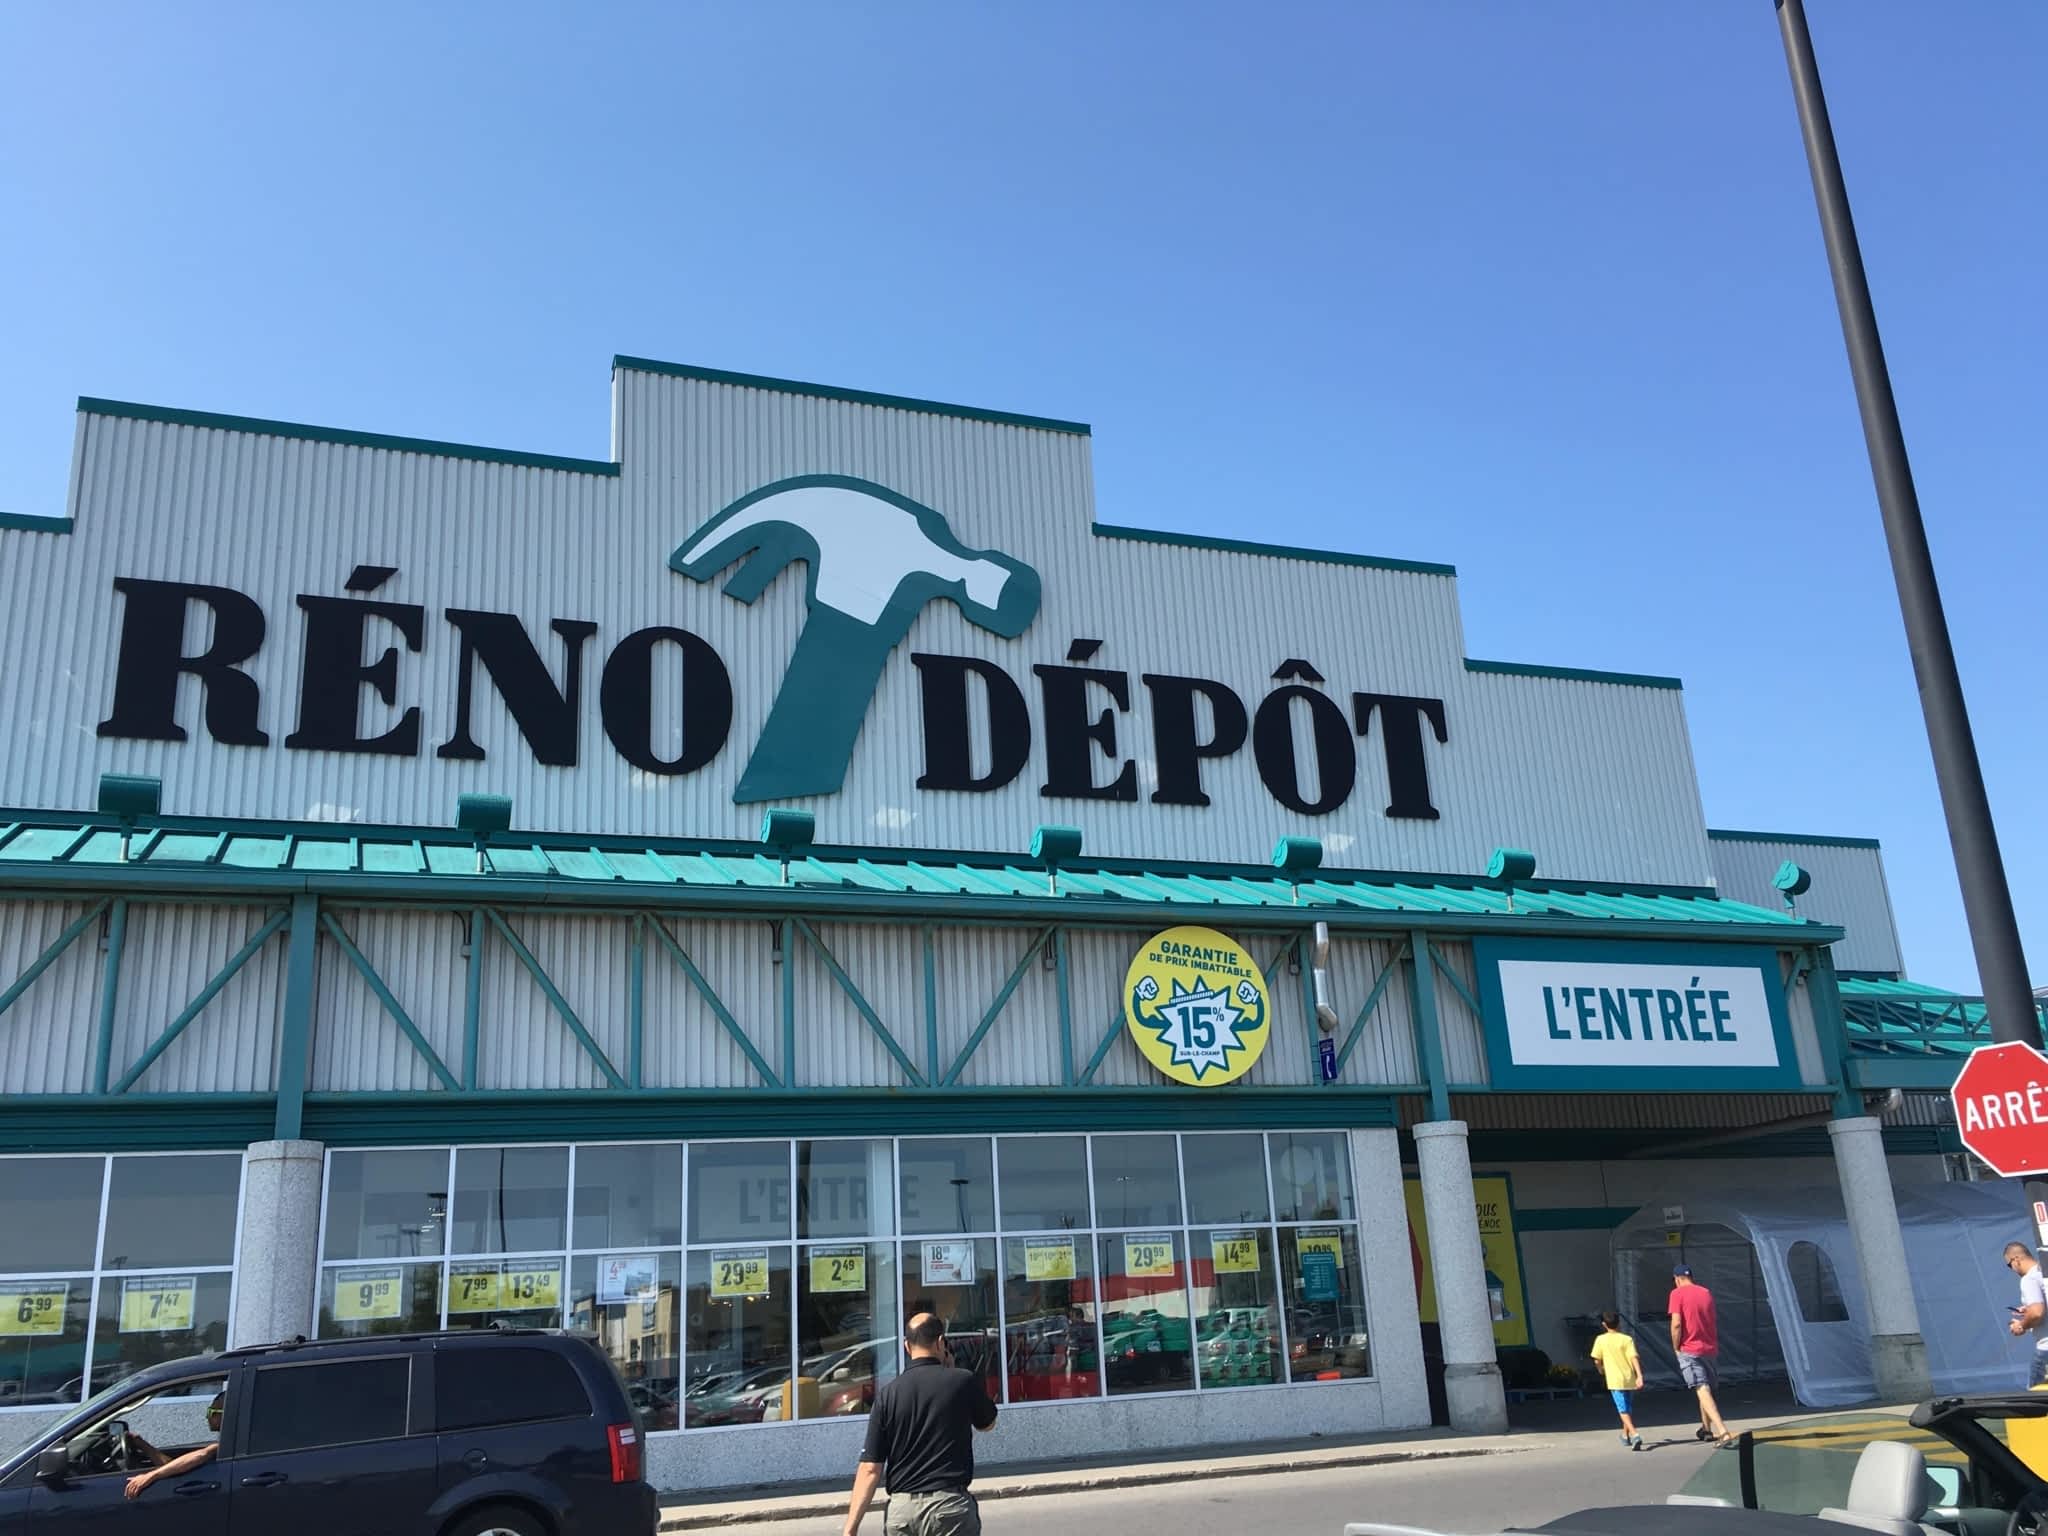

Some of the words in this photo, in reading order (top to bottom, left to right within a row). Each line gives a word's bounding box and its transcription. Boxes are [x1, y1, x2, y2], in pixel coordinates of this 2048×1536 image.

[97, 565, 733, 776] RÉNO
[911, 639, 1448, 820] DÉPÔT
[1149, 953, 1162, 963] DE
[1165, 956, 1188, 967] PRIX
[1191, 960, 1252, 978] IMBATTABLE
[1161, 941, 1237, 965] GARANTIE
[1542, 976, 1737, 1042] L'ENTRÉE
[1966, 1081, 2048, 1132] ARRÊ
[1476, 1203, 1498, 1216] OUS
